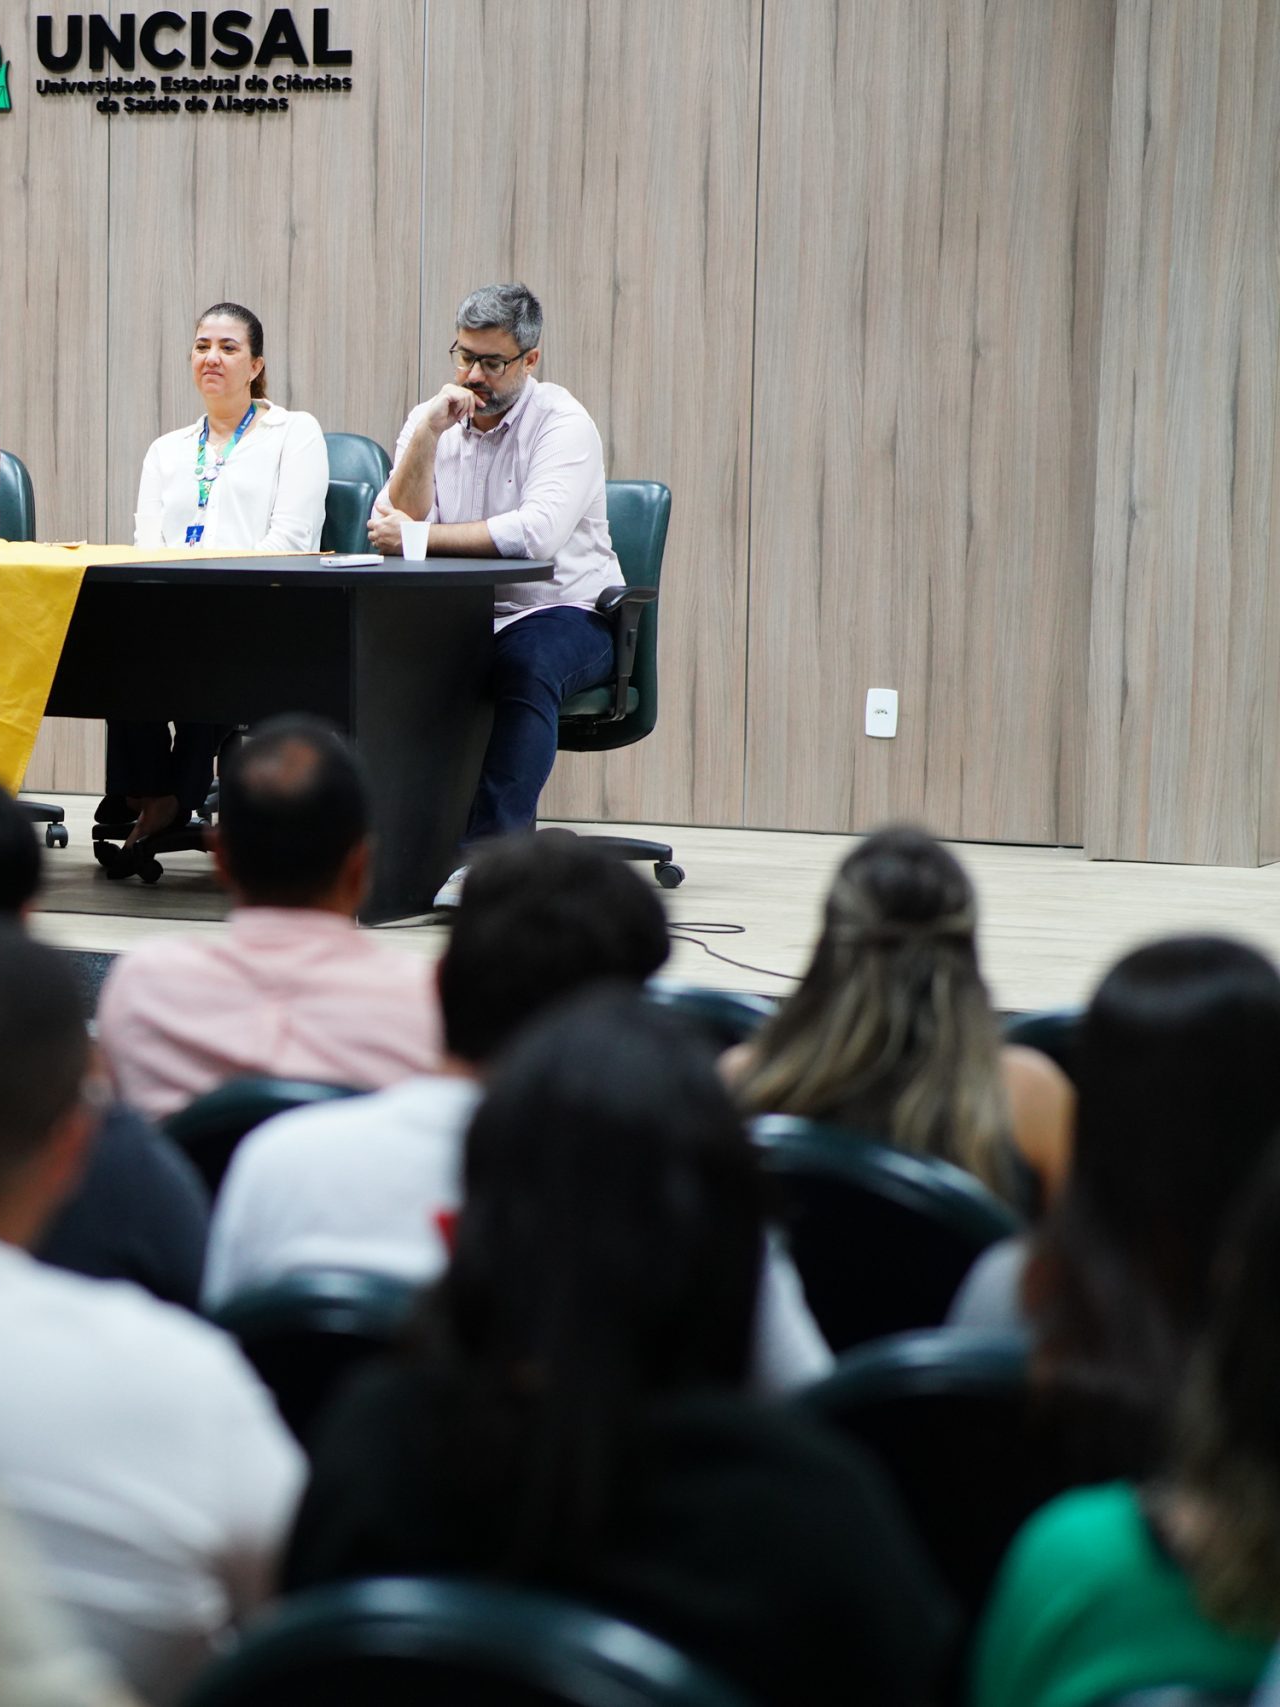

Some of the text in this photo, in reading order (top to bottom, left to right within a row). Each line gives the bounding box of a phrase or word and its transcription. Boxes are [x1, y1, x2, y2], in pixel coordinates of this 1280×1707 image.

[36, 8, 353, 71] UNCISAL
[36, 74, 353, 94] Universidade Estadual de Ciências
[96, 95, 289, 114] da Saúde de Alagoas
